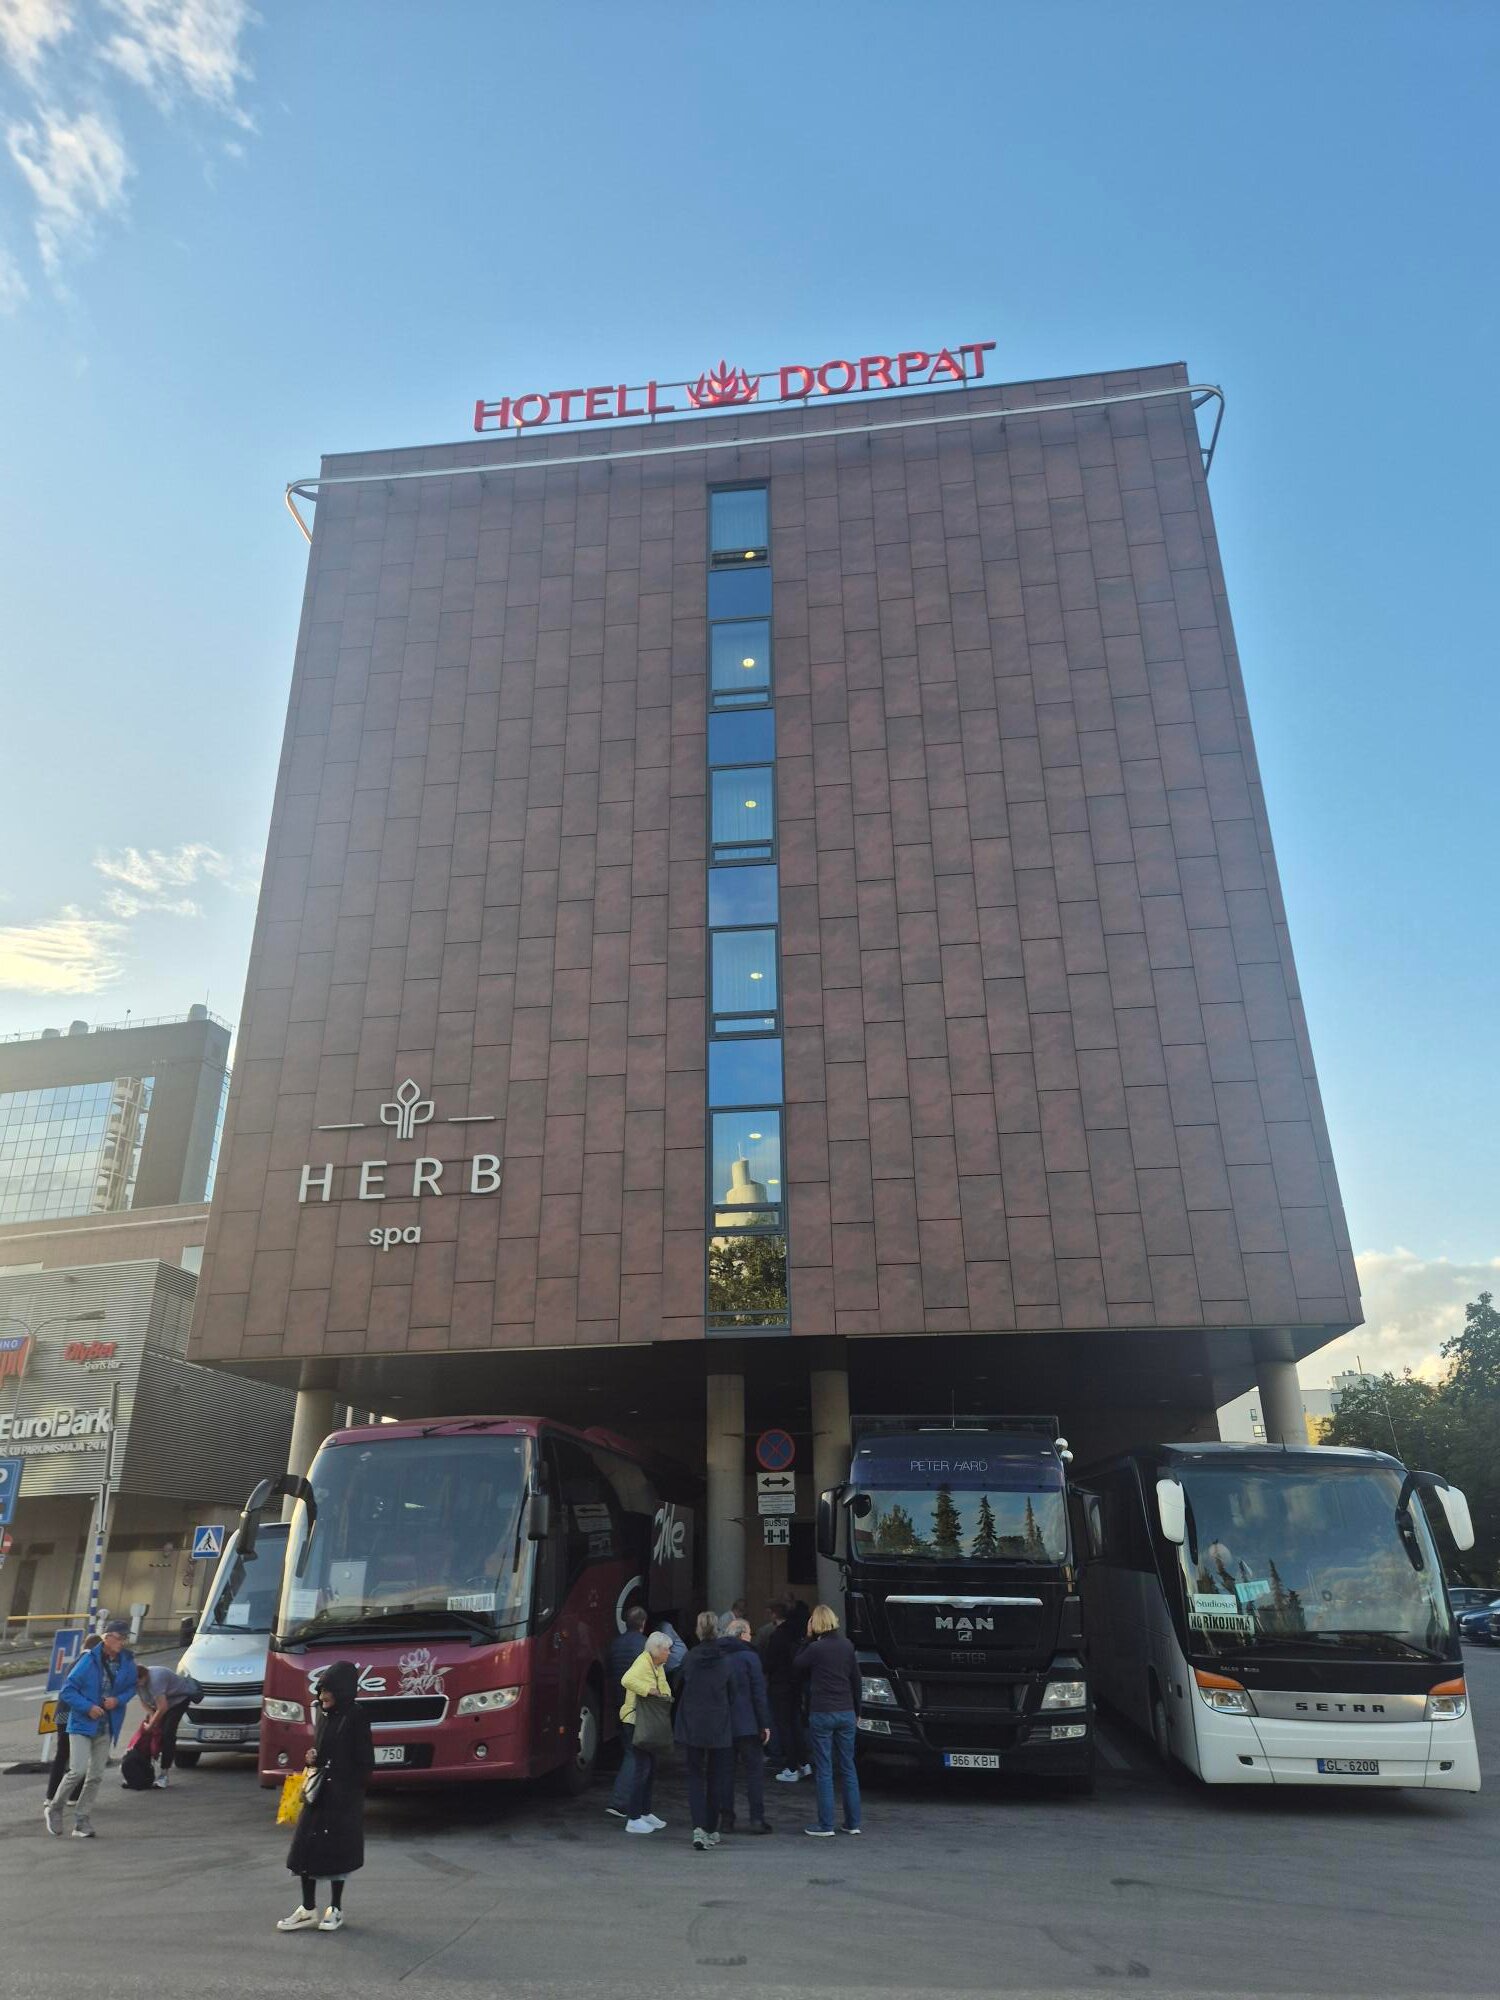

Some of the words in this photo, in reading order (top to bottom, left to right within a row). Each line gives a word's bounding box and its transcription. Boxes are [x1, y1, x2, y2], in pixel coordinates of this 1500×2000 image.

[474, 380, 675, 432] HOTELL
[779, 341, 997, 401] DORPAT
[298, 1154, 502, 1203] HERB
[369, 1226, 422, 1252] spa
[0, 1407, 113, 1440] EuroPark
[910, 1460, 950, 1472] PETER
[953, 1460, 988, 1472] HARD
[764, 1519, 789, 1527] BUSSID
[1195, 1599, 1236, 1609] Studiosus
[935, 1616, 994, 1630] MAN
[213, 1663, 254, 1675] IVECO
[1295, 1702, 1385, 1713] SETRA
[381, 1748, 402, 1760] 750
[952, 1755, 970, 1766] 966
[973, 1756, 997, 1767] KBH
